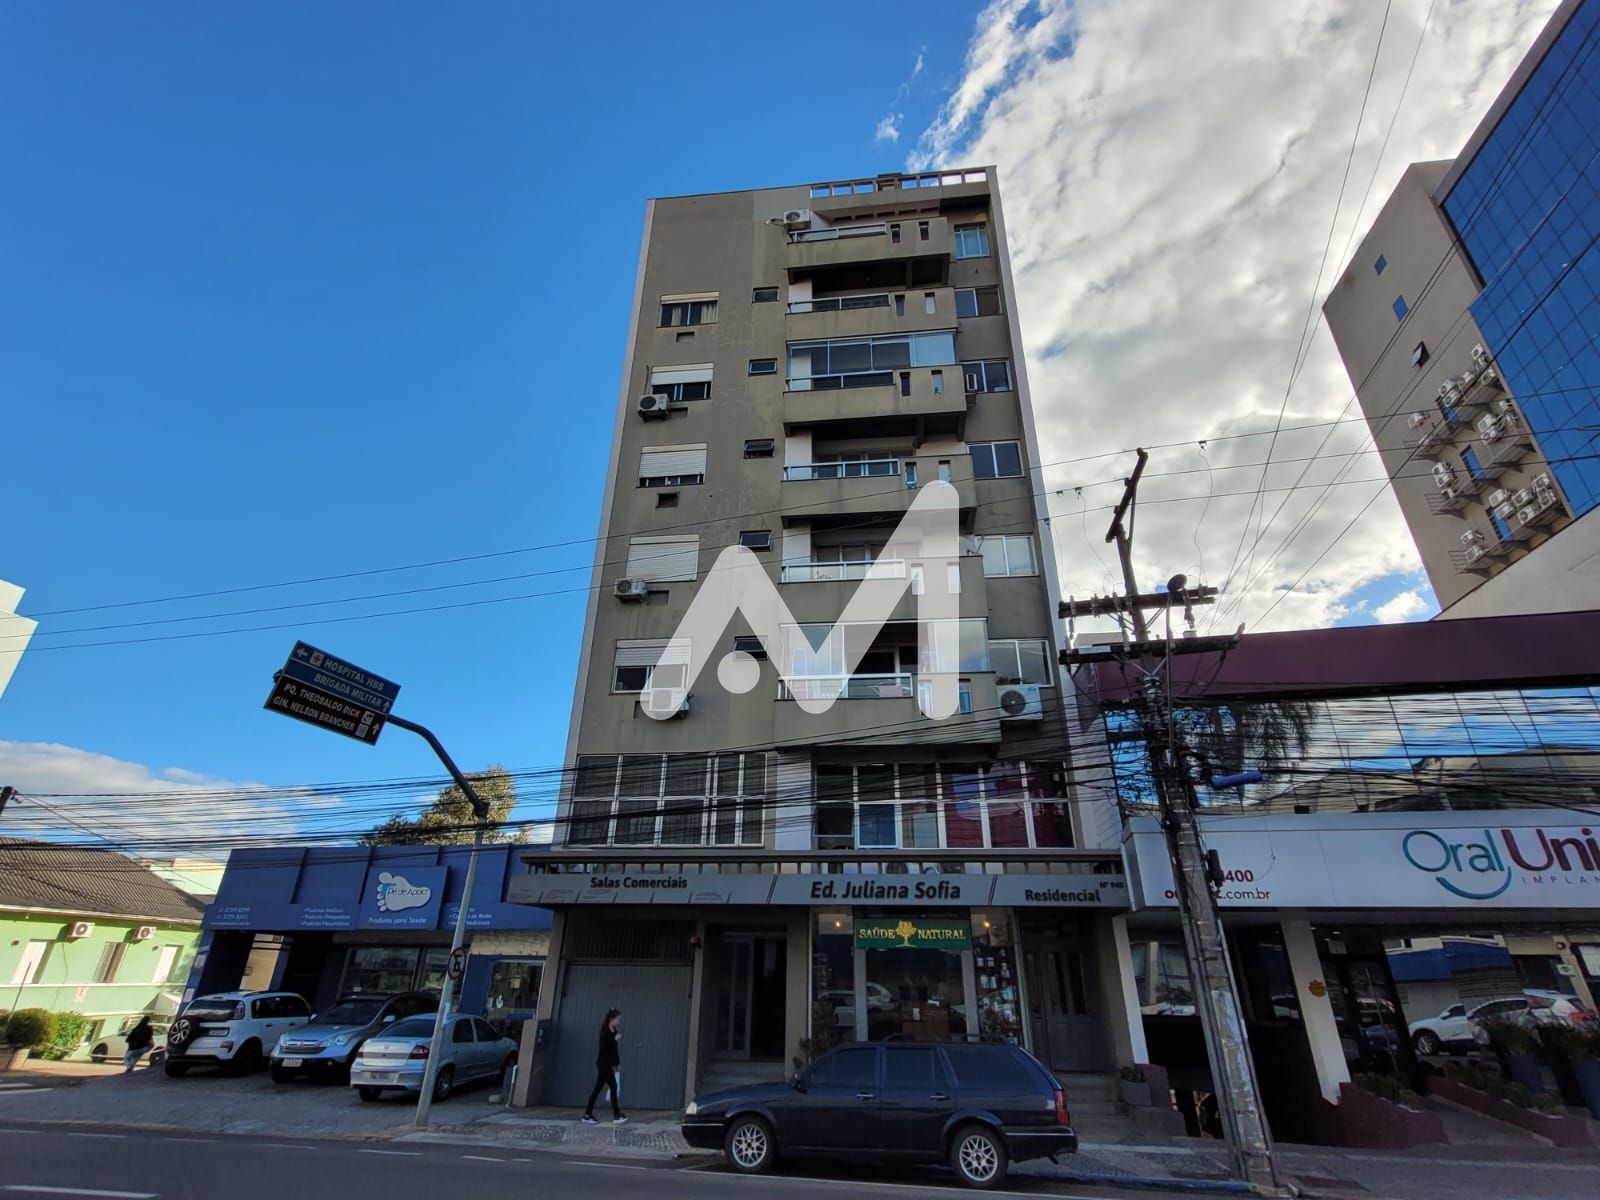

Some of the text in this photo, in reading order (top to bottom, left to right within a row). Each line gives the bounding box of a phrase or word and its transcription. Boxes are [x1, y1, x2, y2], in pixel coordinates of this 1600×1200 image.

[324, 659, 366, 683] HOSPITAL
[284, 683, 361, 719] PQ. THEOBALDO DICK
[314, 673, 382, 708] BRIGADA MILITAR
[290, 701, 320, 719] NELSON
[319, 712, 356, 732] BRANCHER
[590, 876, 688, 889] Salas Comerciais
[810, 881, 961, 899] Ed. Juliana Sofia
[1025, 889, 1101, 903] Residencial
[859, 926, 967, 940] SAÚDE NATURAL
